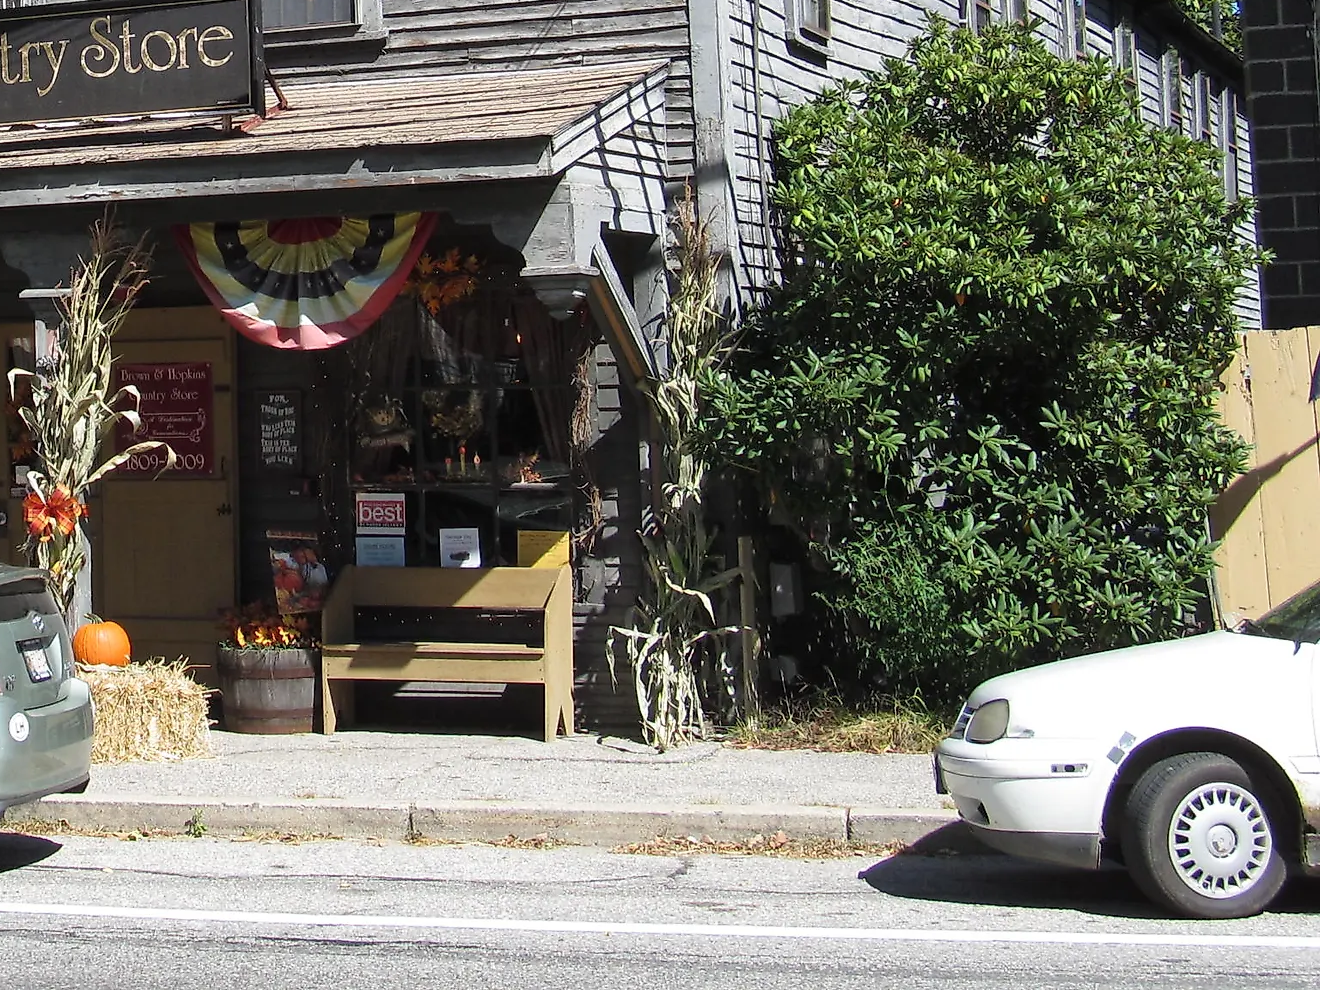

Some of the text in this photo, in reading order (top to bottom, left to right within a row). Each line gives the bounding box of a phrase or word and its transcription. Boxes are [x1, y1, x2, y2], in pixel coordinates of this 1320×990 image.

[80, 15, 235, 78] Store
[120, 368, 206, 383] Brown & Hopkins
[170, 387, 199, 401] Store
[125, 453, 205, 470] 1809-009
[359, 501, 403, 522] best
